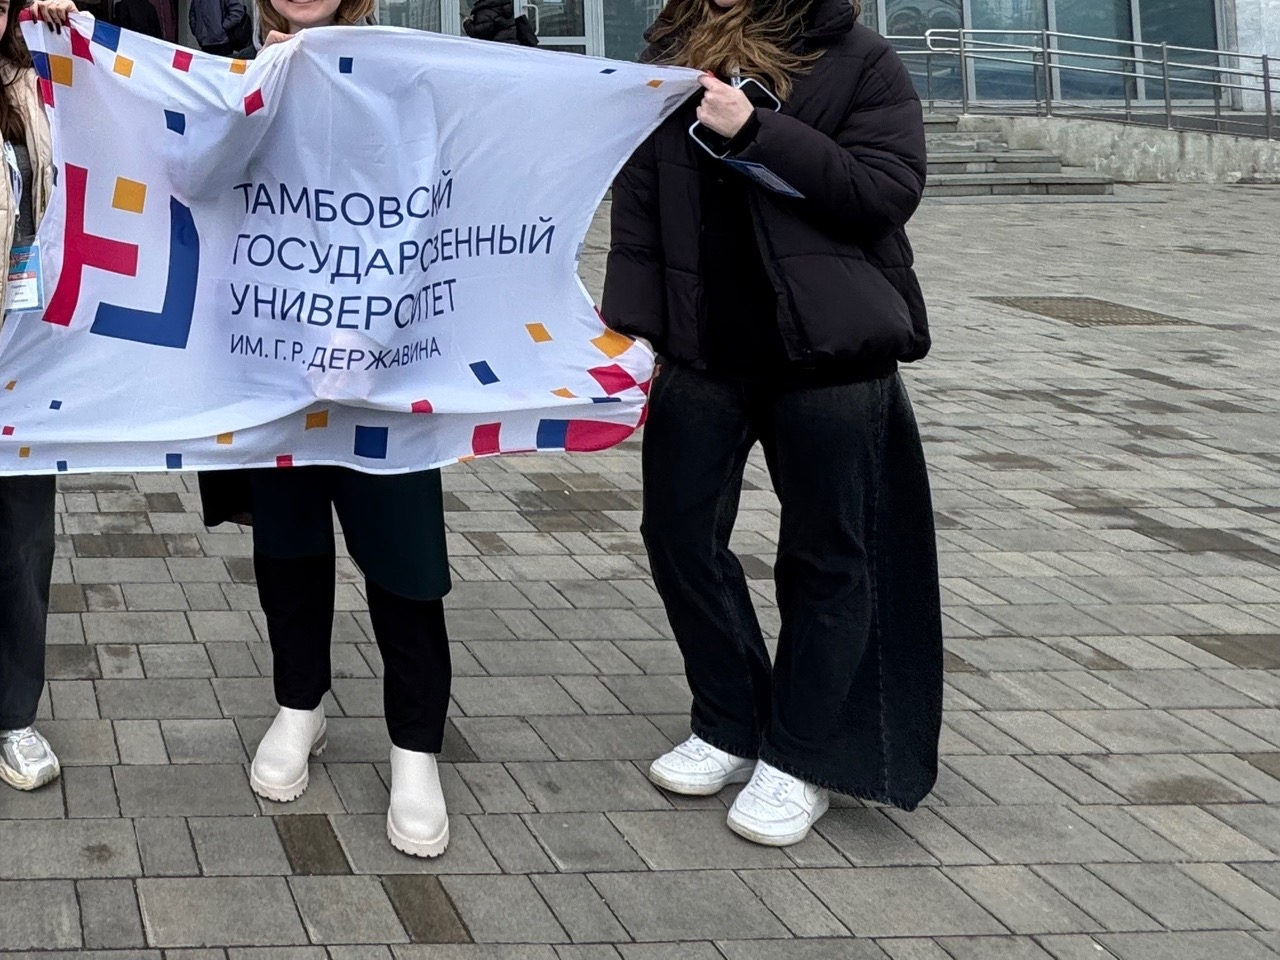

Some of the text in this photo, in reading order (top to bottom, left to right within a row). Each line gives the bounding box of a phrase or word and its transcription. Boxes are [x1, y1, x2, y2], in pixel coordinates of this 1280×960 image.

[232, 169, 454, 229] ТАМБОВСКЙ
[232, 215, 556, 285] ГОСУДАРСВЕННЫЙ
[230, 278, 457, 331] УНИВЕРСИТЕТ
[306, 336, 442, 373] ДЕРЖАВИНА
